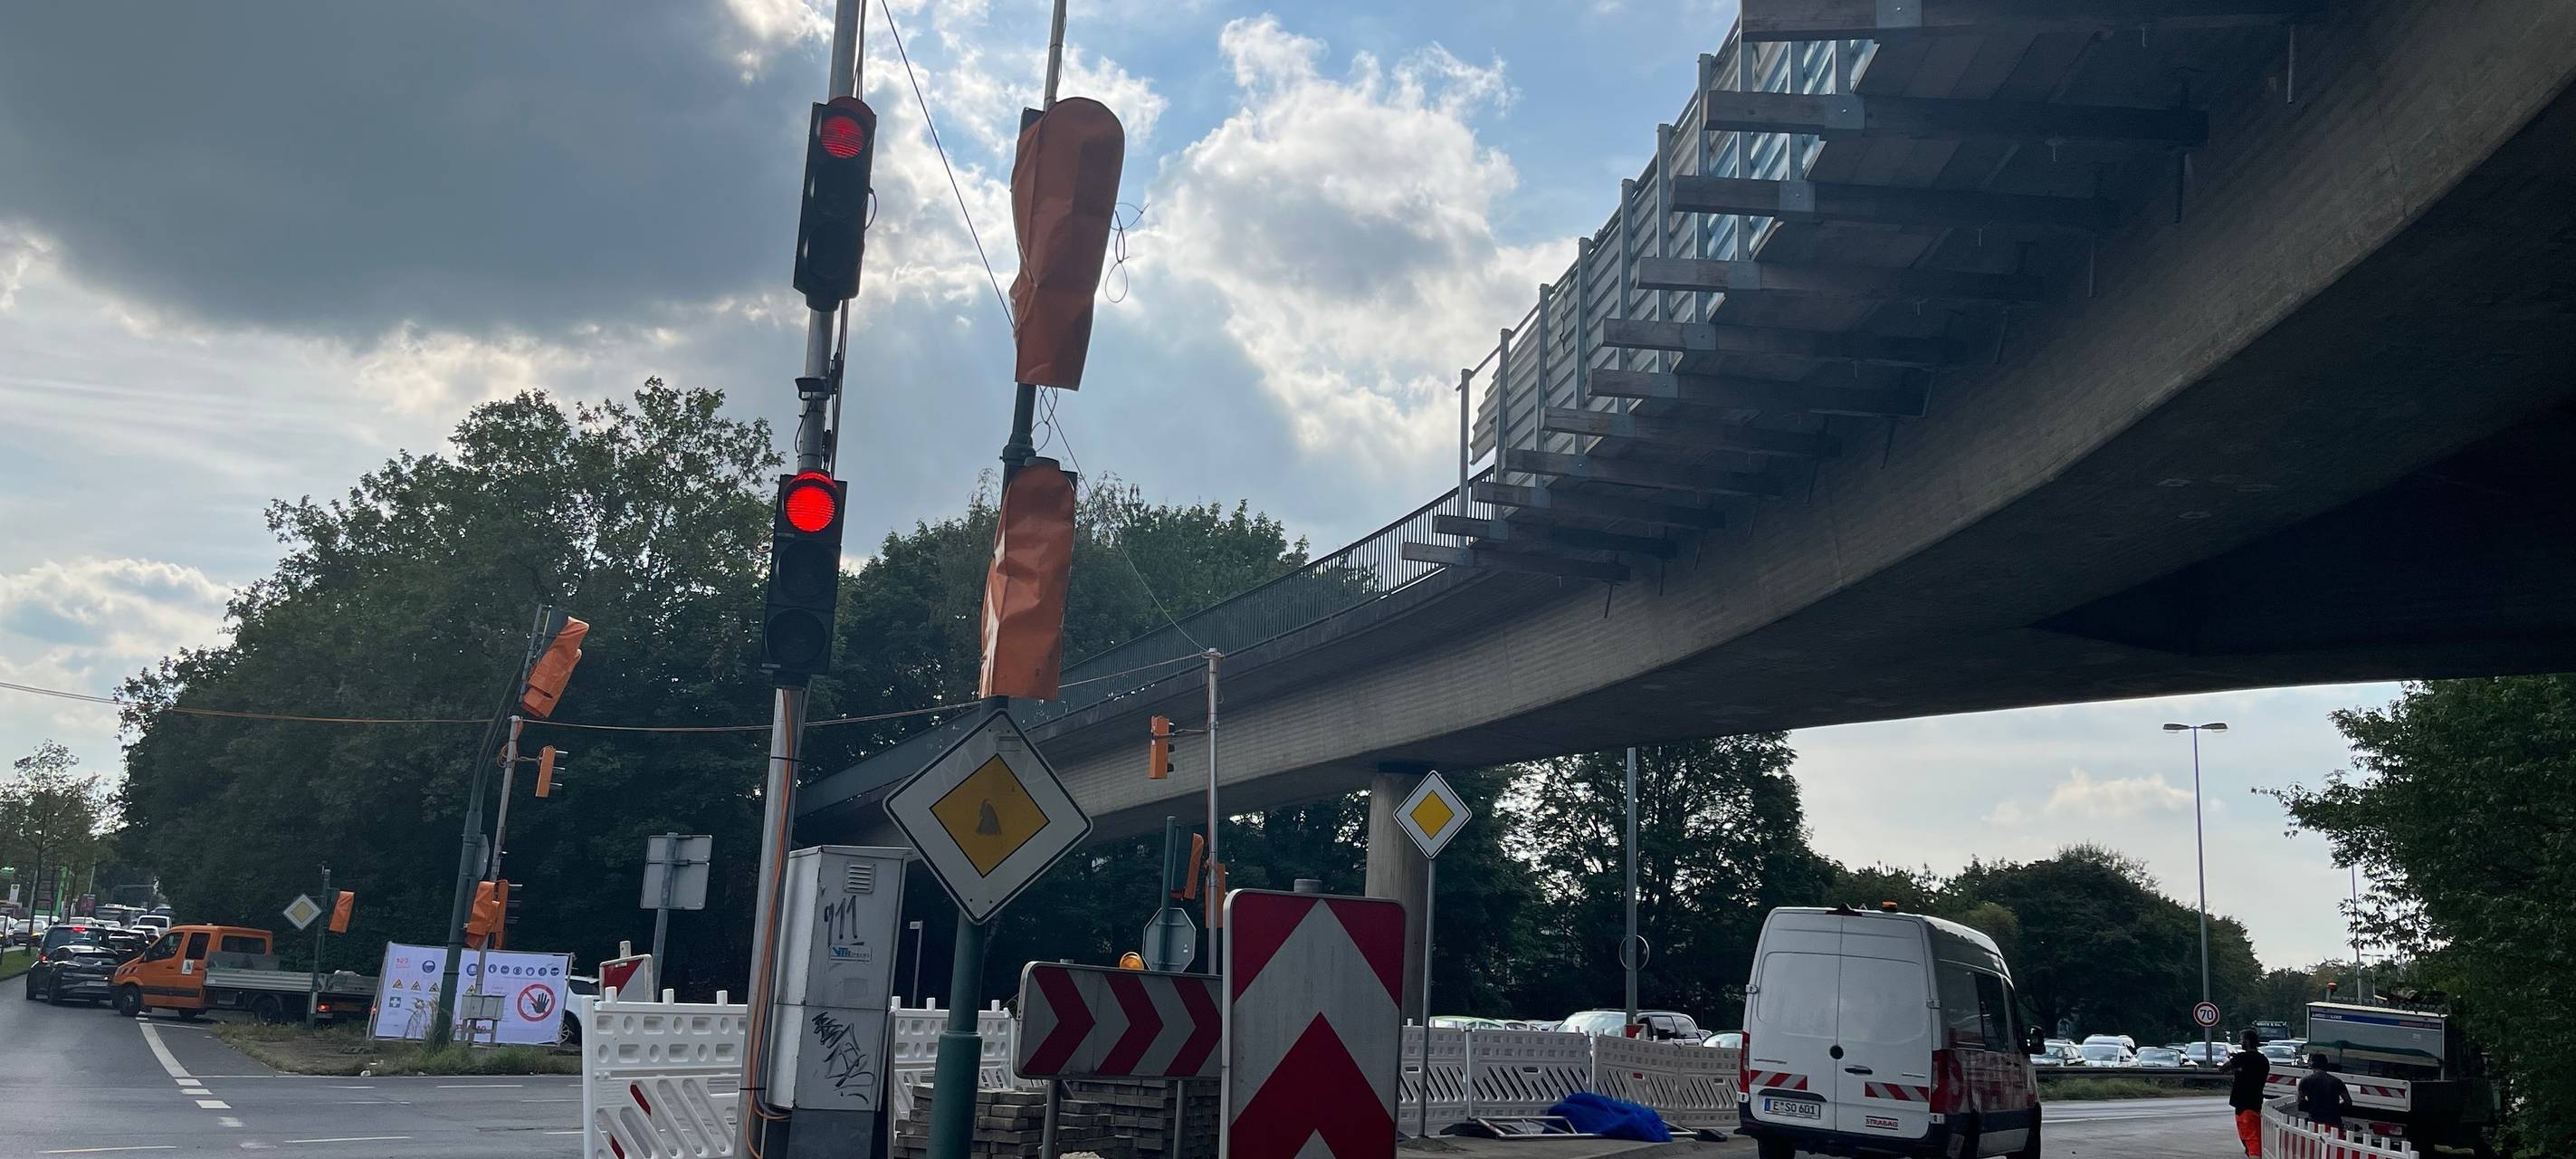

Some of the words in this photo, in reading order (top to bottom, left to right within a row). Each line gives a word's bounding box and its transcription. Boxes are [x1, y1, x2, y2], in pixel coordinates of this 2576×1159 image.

[824, 895, 858, 947] 911
[2199, 1010, 2214, 1020] 70
[1773, 1101, 1779, 1111] E
[1798, 1105, 1815, 1115] 601
[1865, 1118, 1898, 1128] STRABAG
